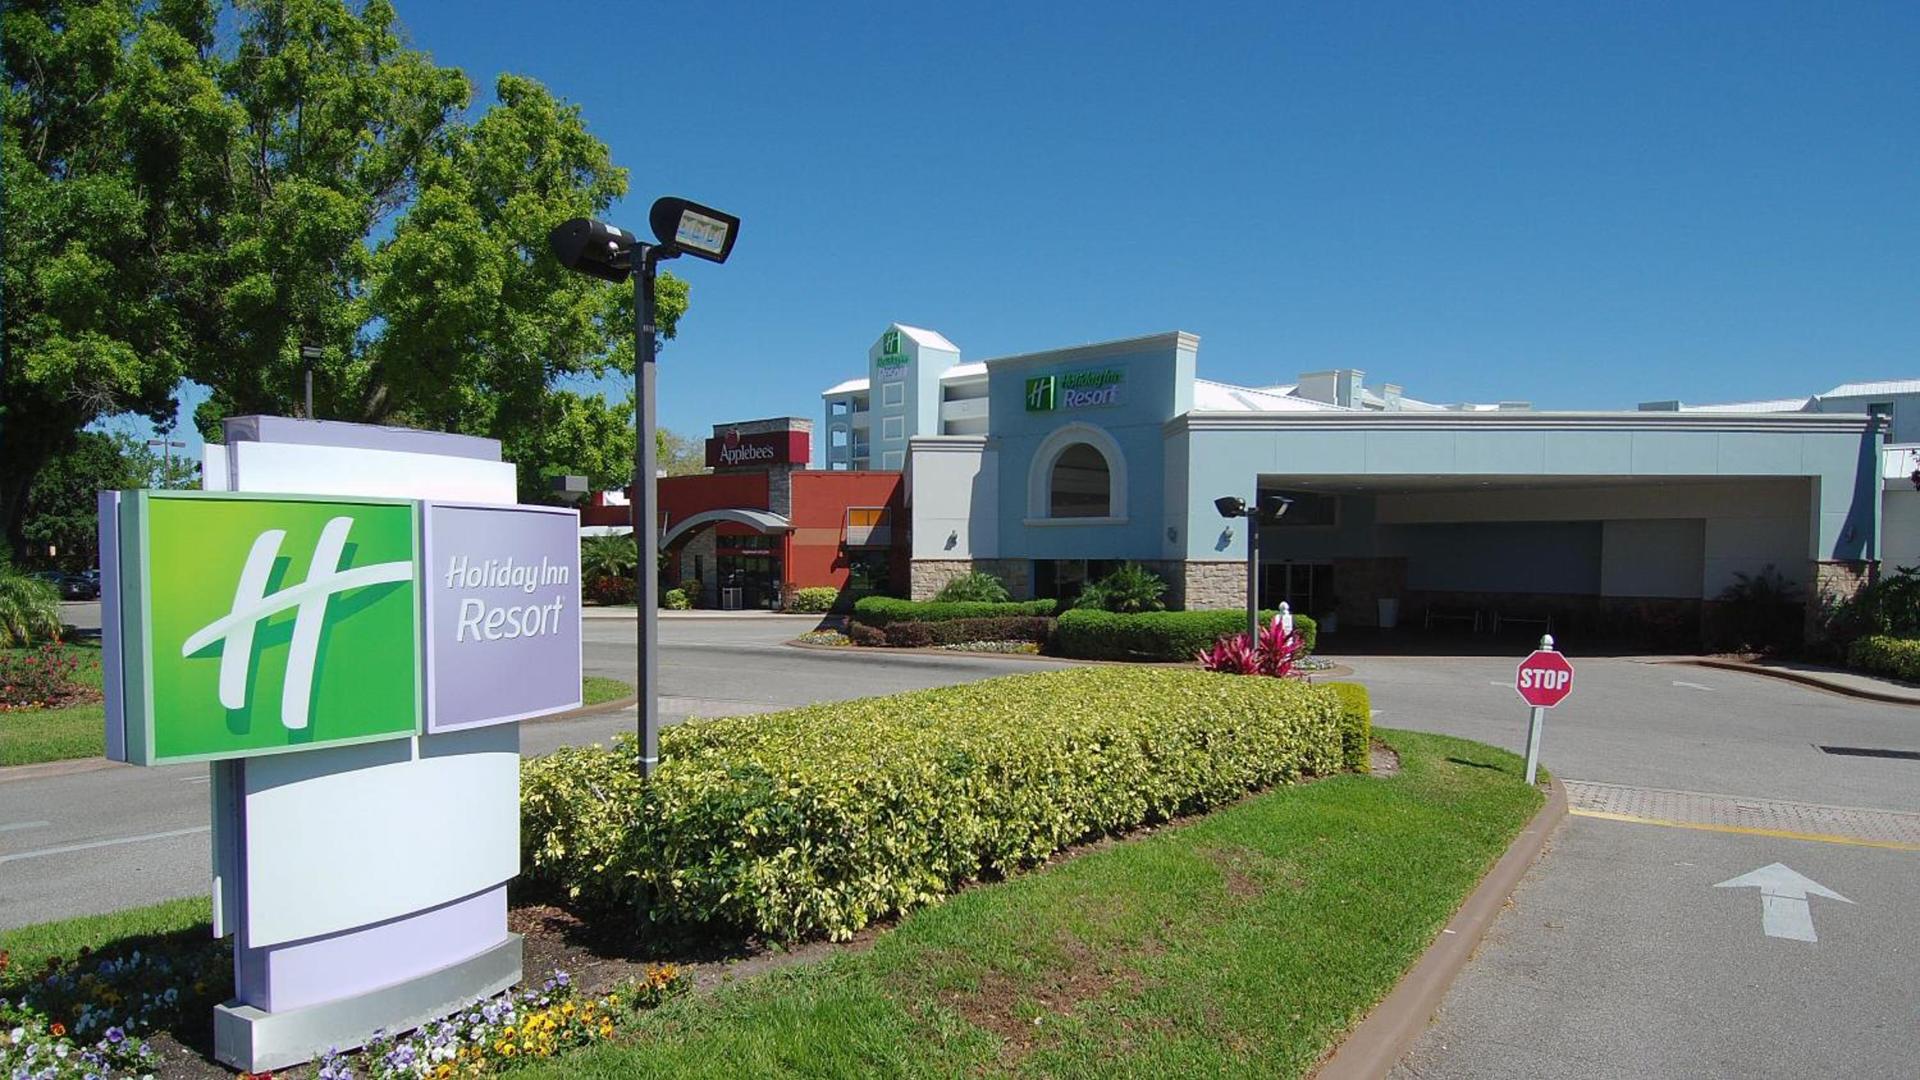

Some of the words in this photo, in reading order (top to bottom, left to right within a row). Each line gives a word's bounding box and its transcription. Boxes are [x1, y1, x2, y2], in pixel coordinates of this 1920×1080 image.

[1064, 385, 1119, 408] Resort
[445, 555, 538, 593] Holiday
[540, 556, 569, 586] Inn
[457, 595, 563, 642] Resort
[1520, 668, 1569, 690] STOP
